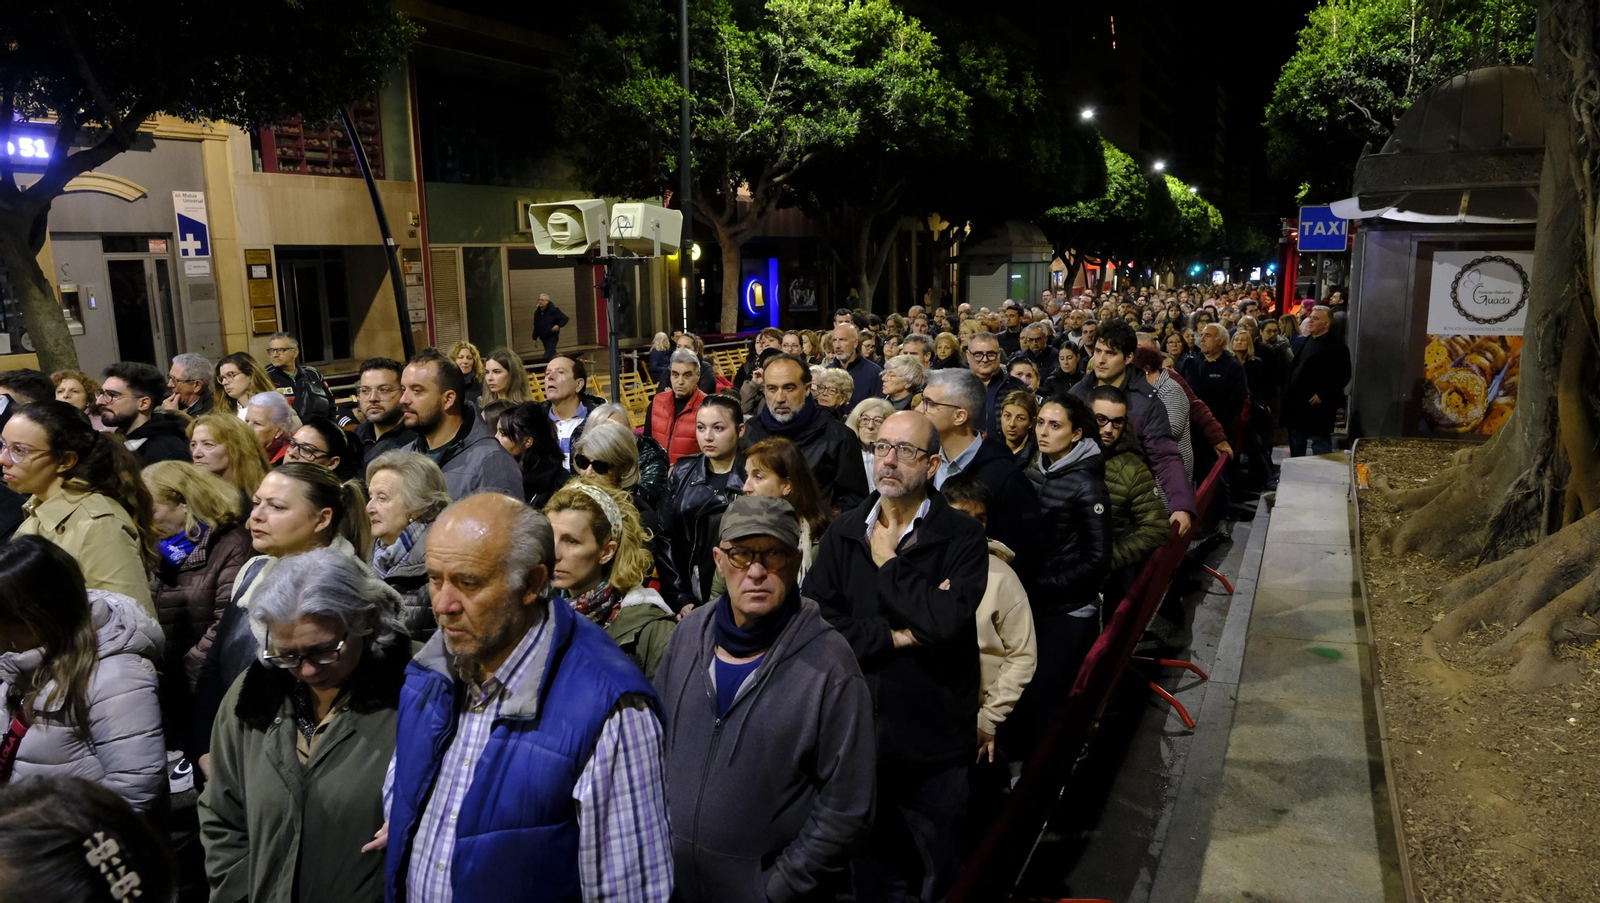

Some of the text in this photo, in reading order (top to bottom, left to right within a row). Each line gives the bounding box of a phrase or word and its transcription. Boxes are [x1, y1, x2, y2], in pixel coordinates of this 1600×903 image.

[18, 137, 49, 158] 51
[1301, 221, 1346, 236] TAXI
[1473, 283, 1510, 306] Guada
